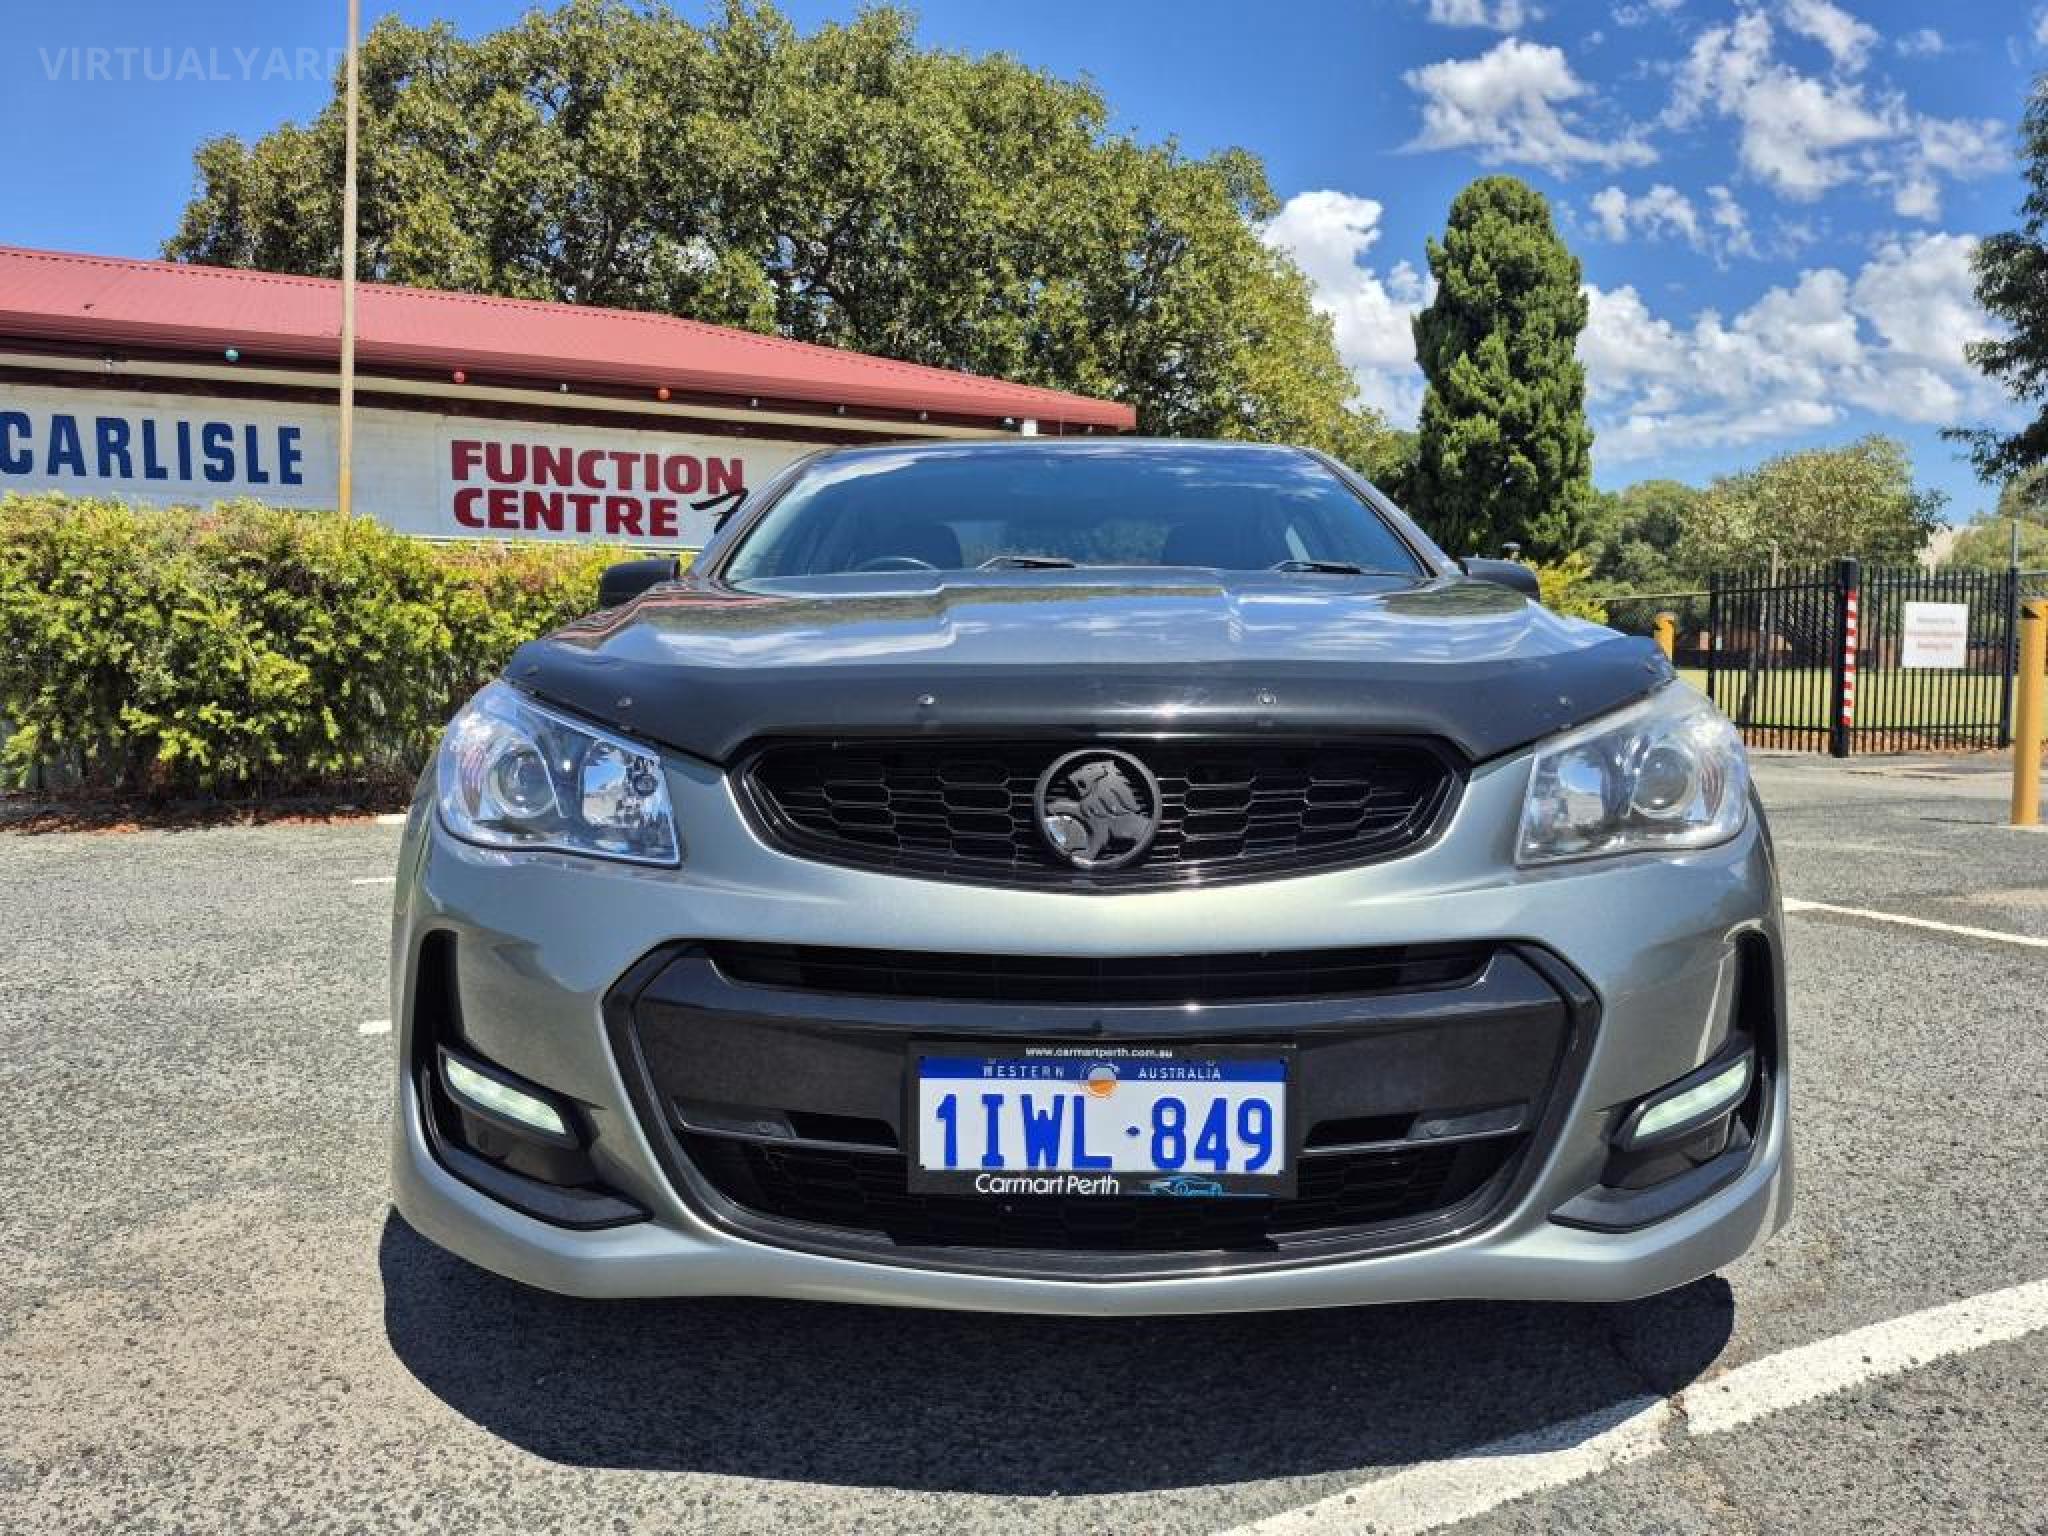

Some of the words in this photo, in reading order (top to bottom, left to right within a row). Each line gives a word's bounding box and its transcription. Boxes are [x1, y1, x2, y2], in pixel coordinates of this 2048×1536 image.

[0, 411, 303, 485] CARLISLE
[450, 439, 745, 495] FUNCTION
[454, 487, 679, 537] CENTRE
[1025, 1047, 1173, 1059] www.carmartperth.com.au
[983, 1065, 1065, 1078] WESTERN
[1137, 1067, 1222, 1080] AUSTRALIA
[975, 1174, 1063, 1196] Carmart
[1067, 1175, 1119, 1196] Perth
